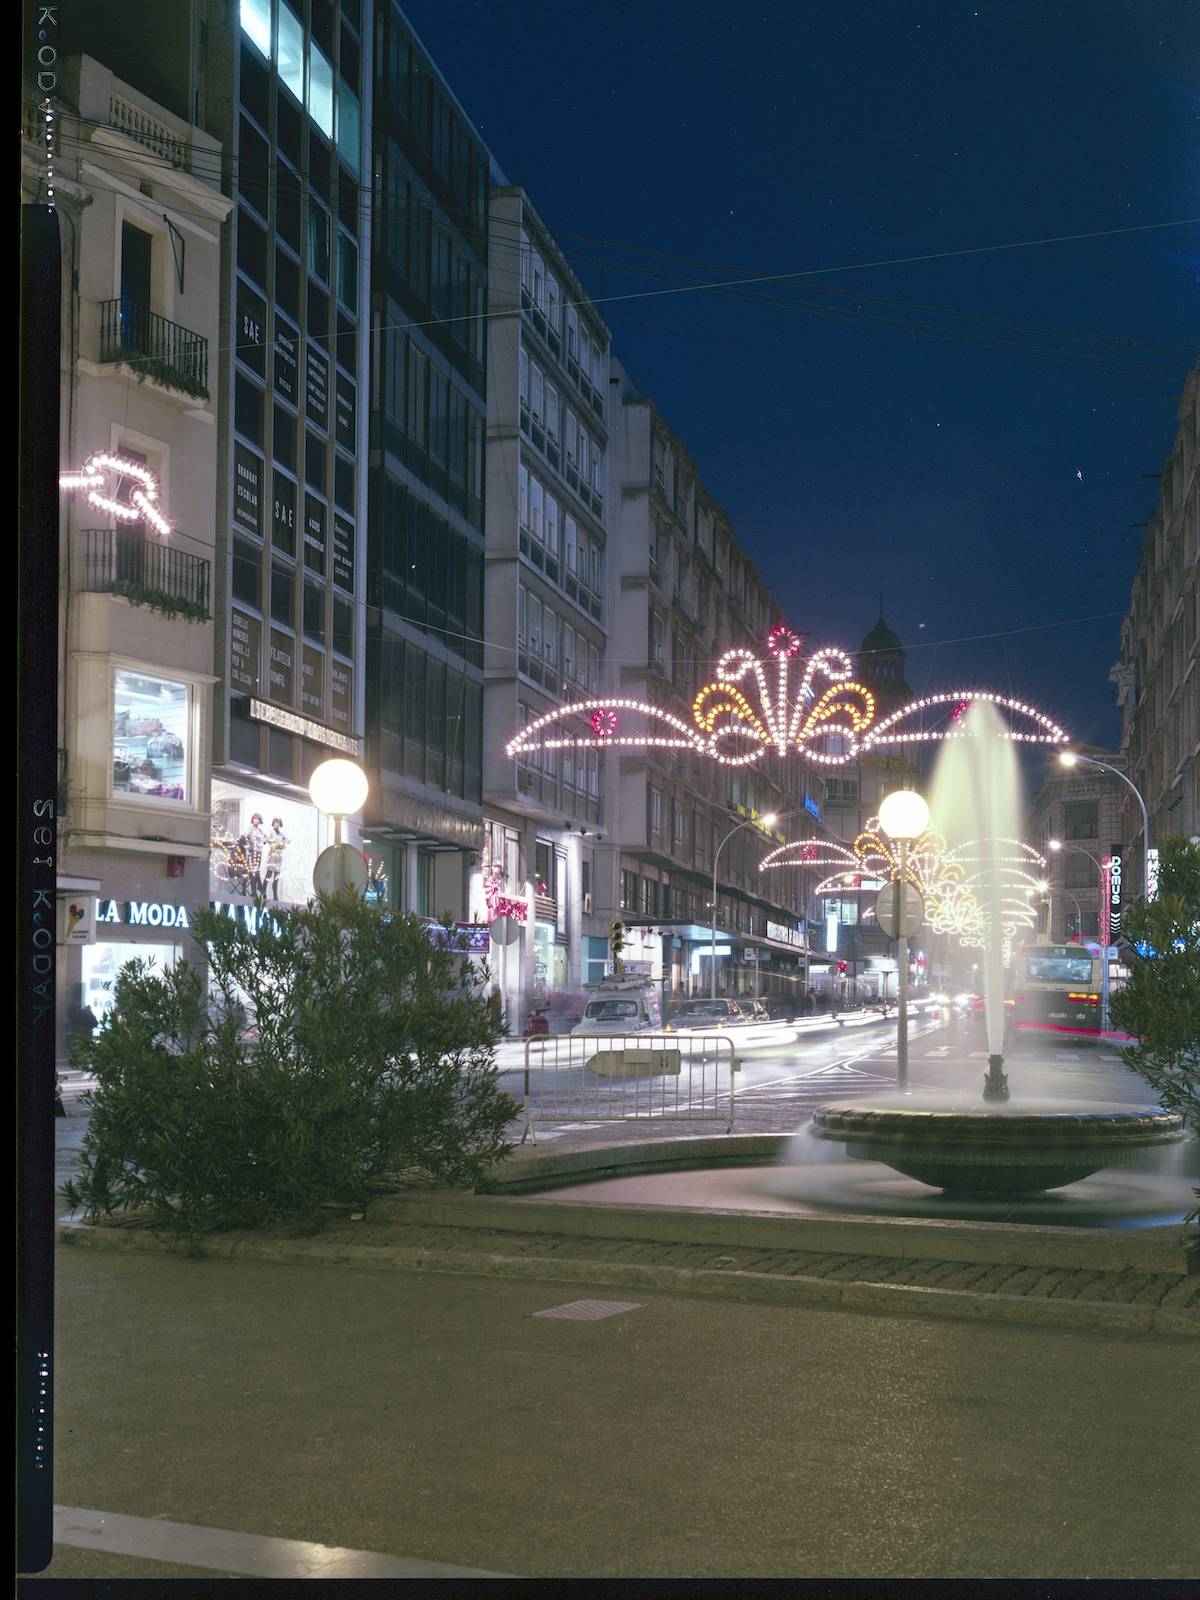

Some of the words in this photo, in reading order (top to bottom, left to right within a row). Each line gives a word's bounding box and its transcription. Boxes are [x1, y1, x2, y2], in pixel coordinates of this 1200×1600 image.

[243, 315, 260, 345] SAE
[274, 500, 294, 528] SAE
[95, 898, 120, 922] LA
[130, 901, 189, 928] MODA
